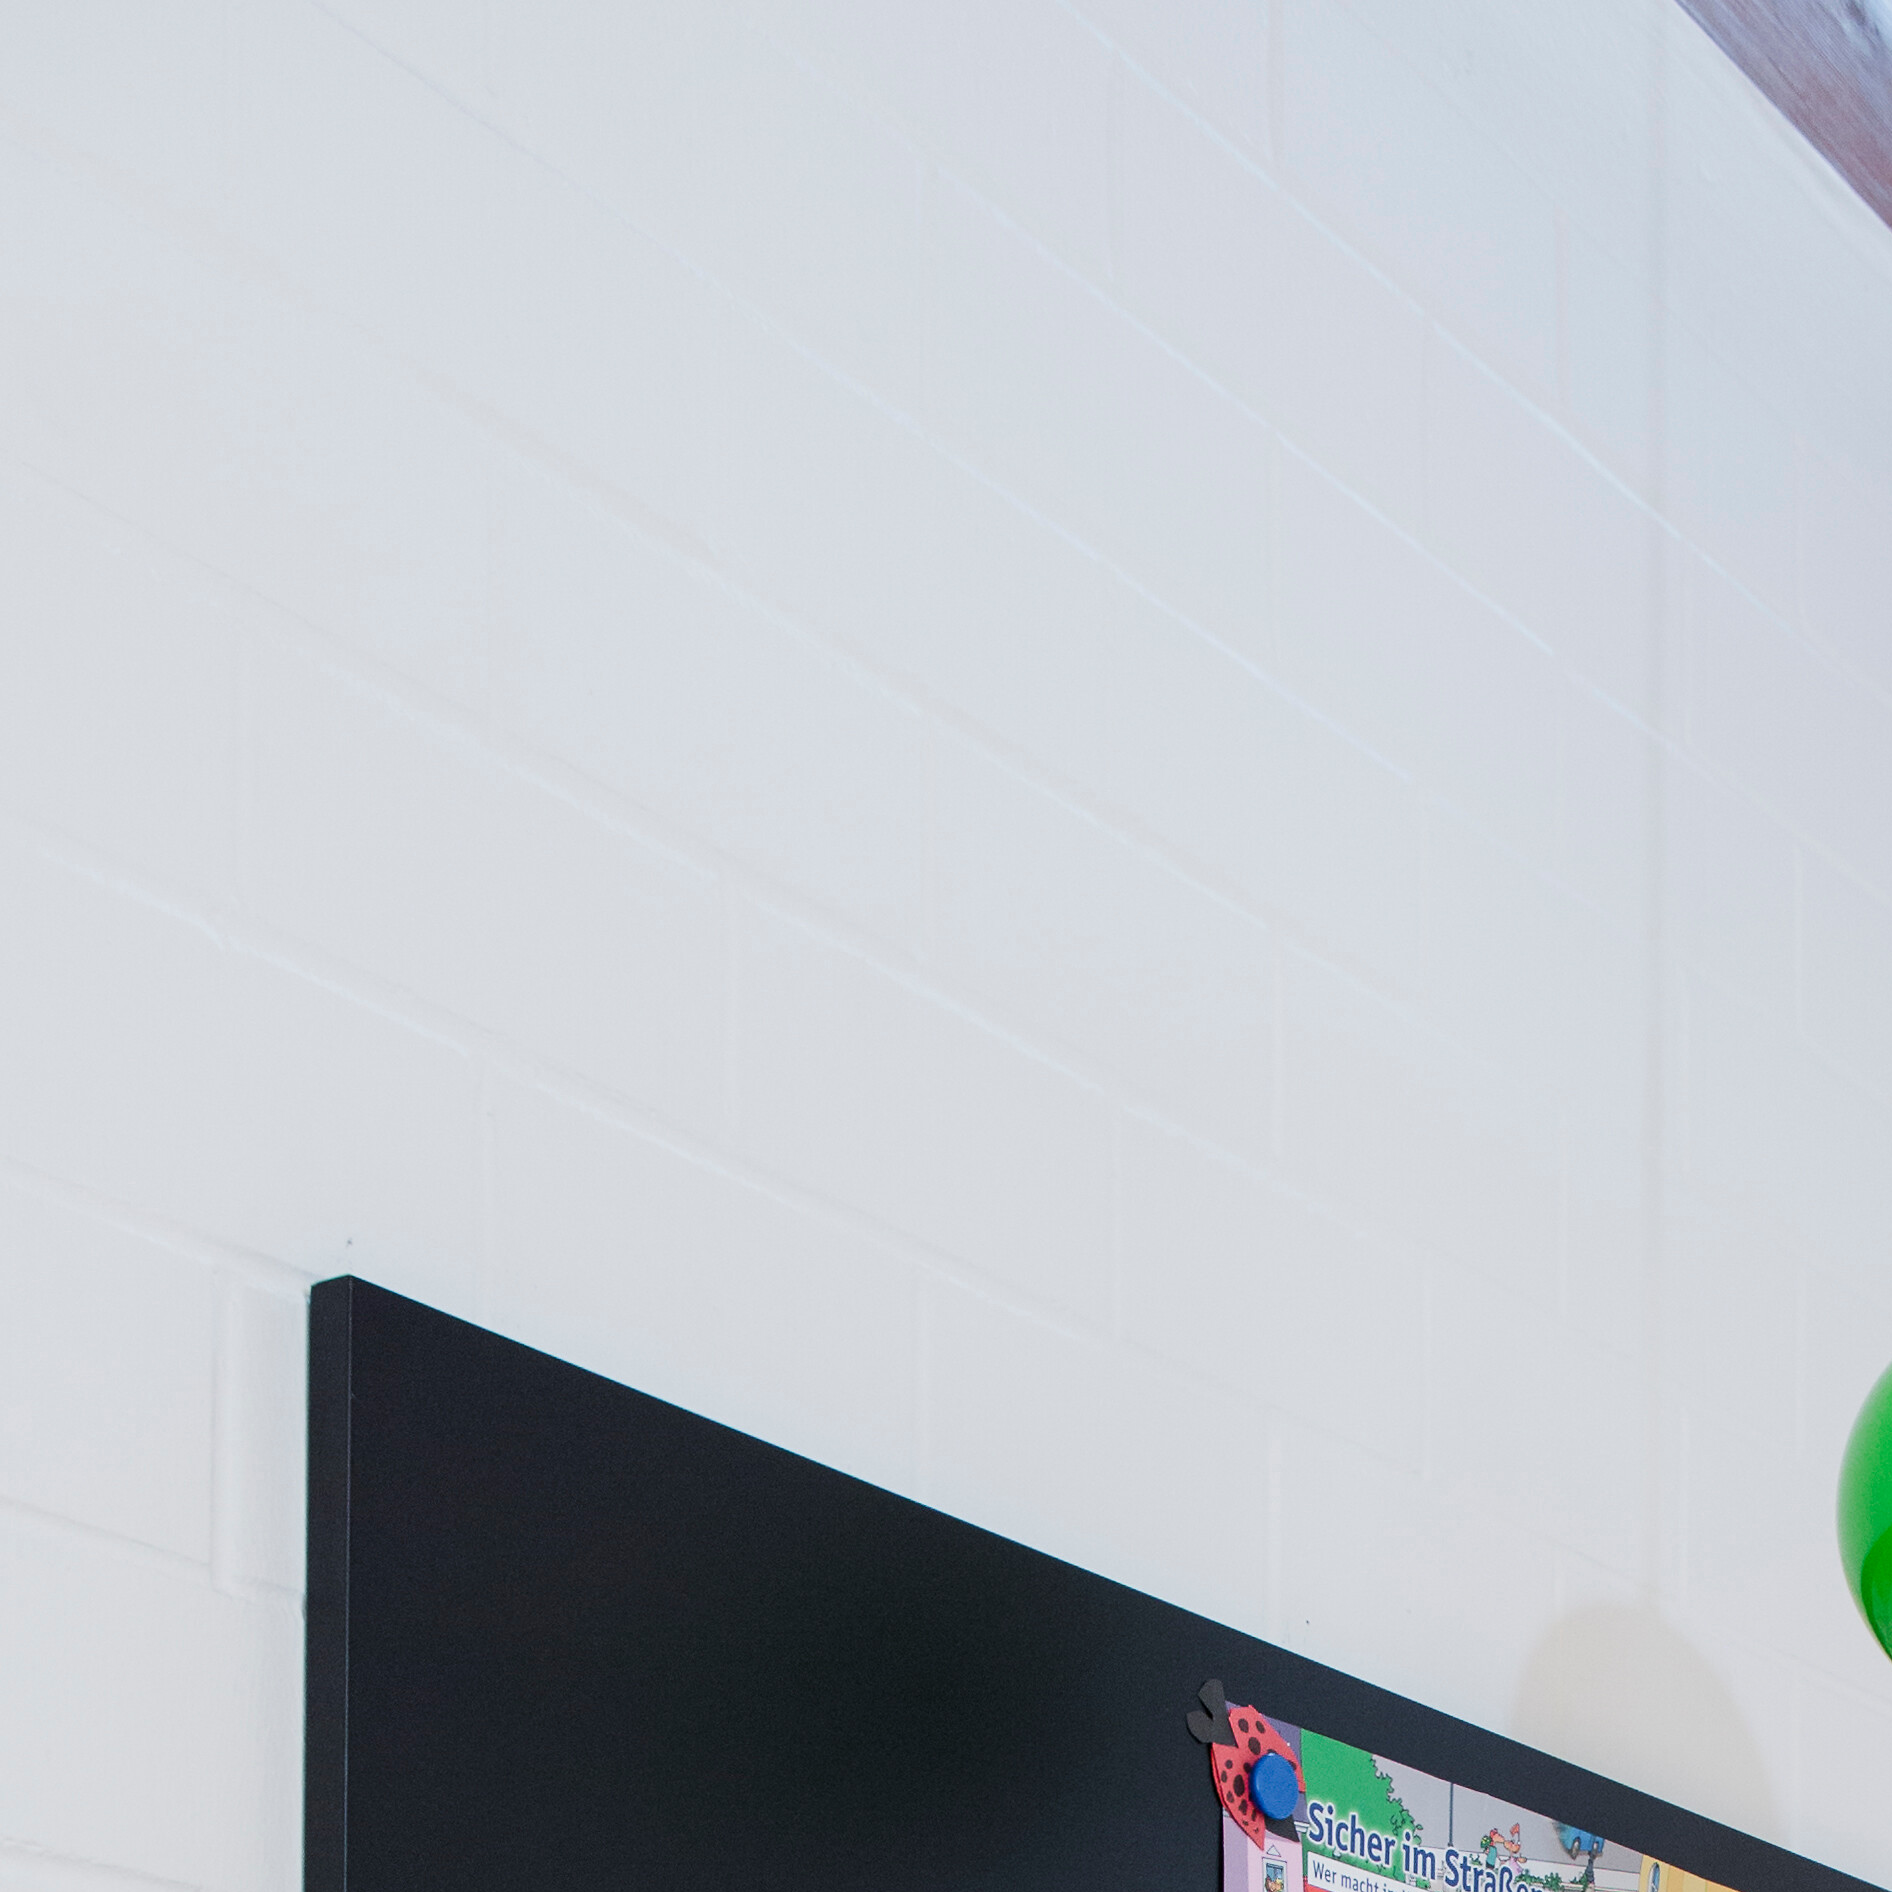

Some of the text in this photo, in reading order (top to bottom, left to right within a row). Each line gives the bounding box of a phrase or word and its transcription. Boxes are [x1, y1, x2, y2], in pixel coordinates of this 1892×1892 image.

[1308, 1802, 1396, 1866] Sicher
[1402, 1832, 1436, 1880] im
[1313, 1860, 1337, 1884] Wer
